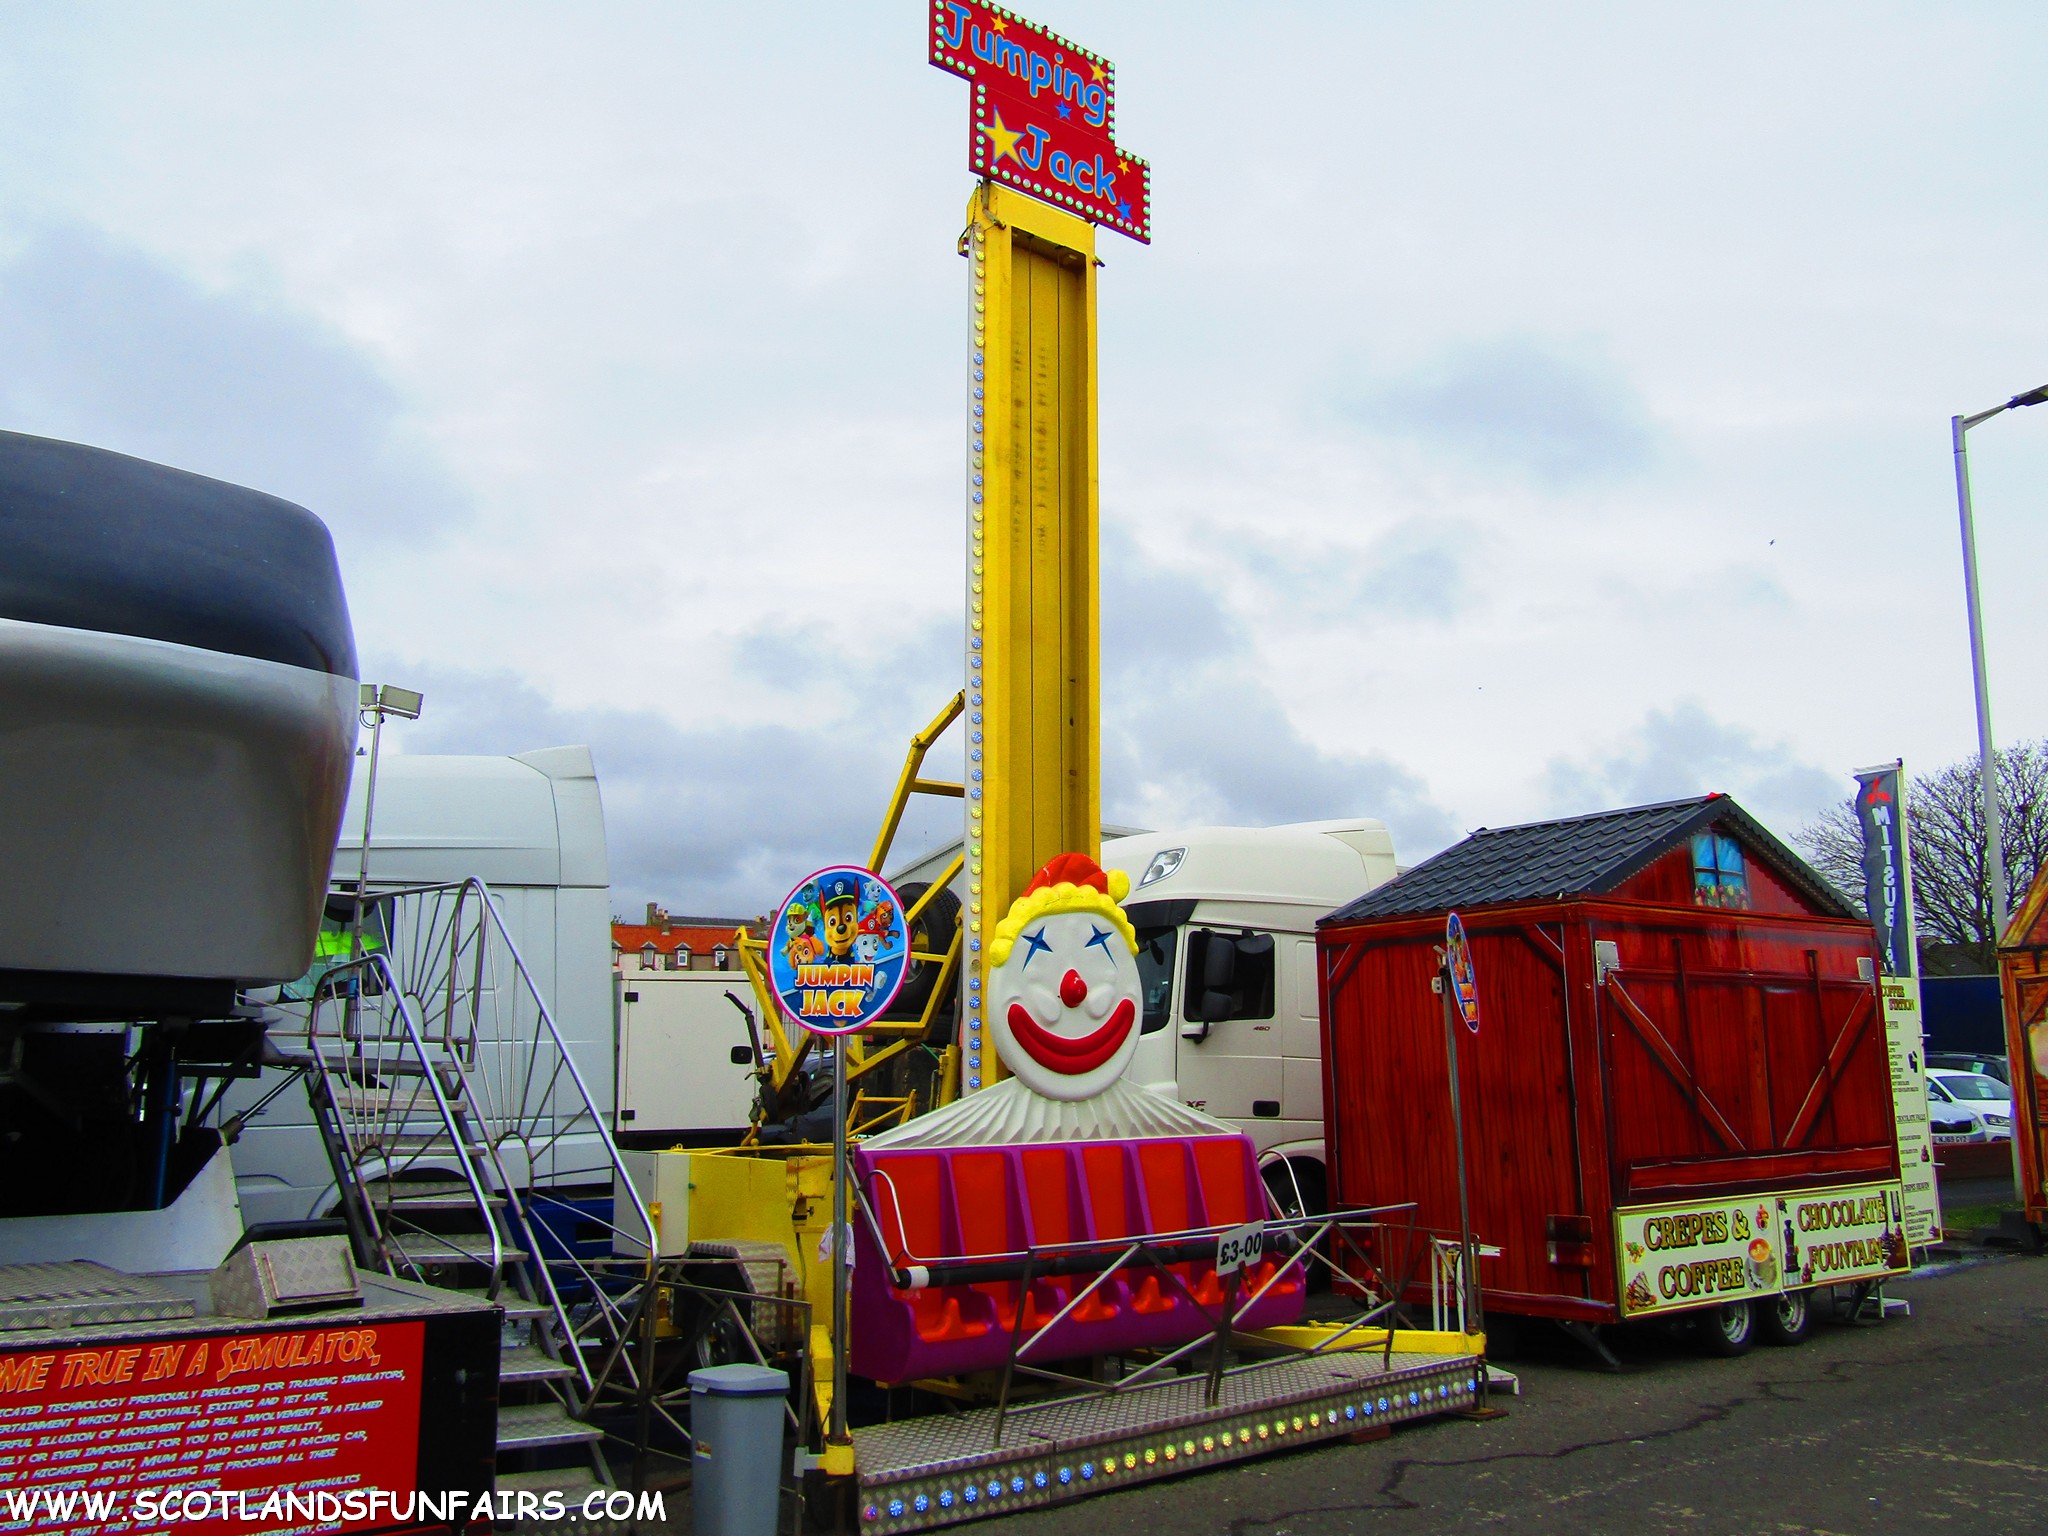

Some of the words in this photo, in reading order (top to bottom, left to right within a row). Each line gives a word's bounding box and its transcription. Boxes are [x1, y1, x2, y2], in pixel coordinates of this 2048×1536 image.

[941, 1, 1106, 128] Jumping
[1020, 124, 1116, 204] Jack
[795, 964, 875, 988] JUMPIN
[799, 989, 866, 1018] JACK
[1644, 1211, 1729, 1250] CREPES
[1732, 1209, 1751, 1241] &
[1797, 1195, 1887, 1232] CHOCOLATE
[1220, 1232, 1262, 1266] £3-00
[1807, 1237, 1884, 1272] FOUNTAIN
[1658, 1257, 1744, 1299] COFFEE
[0, 1355, 56, 1393] ME
[60, 1349, 142, 1388] TRUE
[142, 1345, 186, 1382] IN
[185, 1343, 209, 1377] A
[216, 1330, 381, 1382] SIMULATOR,
[48, 1397, 128, 1414] TECHNOLOGY
[129, 1390, 199, 1405] PREVIOUSLY
[201, 1384, 260, 1398] DEVELOPED
[263, 1382, 285, 1392] FOR
[289, 1376, 339, 1389] TRAINING
[341, 1370, 406, 1384] SIMULATORS,
[78, 1414, 119, 1427] WHICH
[123, 1412, 135, 1421] IS
[137, 1405, 202, 1420] ENJOYABLE,
[206, 1400, 255, 1415] EXITING
[257, 1397, 280, 1407] AND
[283, 1394, 302, 1404] YET
[304, 1392, 329, 1402] SAFE,
[29, 1453, 48, 1463] OR
[51, 1450, 84, 1461] EVEN
[83, 1440, 156, 1457] IMPOSSIBLE
[157, 1438, 181, 1448] FOR
[185, 1434, 209, 1445] YOU
[213, 1431, 229, 1441] TO
[231, 1428, 260, 1440] HAVE
[262, 1426, 276, 1436] IN
[277, 1421, 323, 1434] REALITY,
[37, 1432, 96, 1447] ILLUSION
[99, 1429, 115, 1439] OF
[118, 1422, 185, 1438] MOVEMENT
[187, 1419, 210, 1430] AND
[212, 1415, 238, 1427] REAL
[243, 1407, 317, 1424] INVOLVEMENT
[319, 1406, 332, 1415] IN
[335, 1405, 343, 1413] A
[343, 1400, 383, 1413] FILMED
[20, 1470, 28, 1480] A
[32, 1463, 99, 1478] HIGHSPEED
[101, 1458, 137, 1471] BOAT,
[140, 1453, 177, 1468] MUM
[180, 1450, 204, 1460] AND
[205, 1448, 231, 1460] DAD
[234, 1444, 258, 1455] CAN
[260, 1440, 287, 1451] RIDE
[288, 1438, 296, 1447] A
[299, 1433, 341, 1446] RACING
[344, 1430, 368, 1442] CAR,
[25, 1480, 87, 1494] TOGETHER
[90, 1477, 115, 1487] AND
[117, 1474, 134, 1484] BY
[137, 1466, 199, 1482] CHANGING
[202, 1463, 224, 1473] THE
[225, 1455, 282, 1470] PROGRAM
[284, 1453, 304, 1463] ALL
[309, 1448, 339, 1459] THESE
[168, 1478, 222, 1494] MACHINE,
[277, 1483, 297, 1493] THE
[297, 1474, 361, 1490] HYDRAULICS
[104, 1521, 133, 1533] THEY
